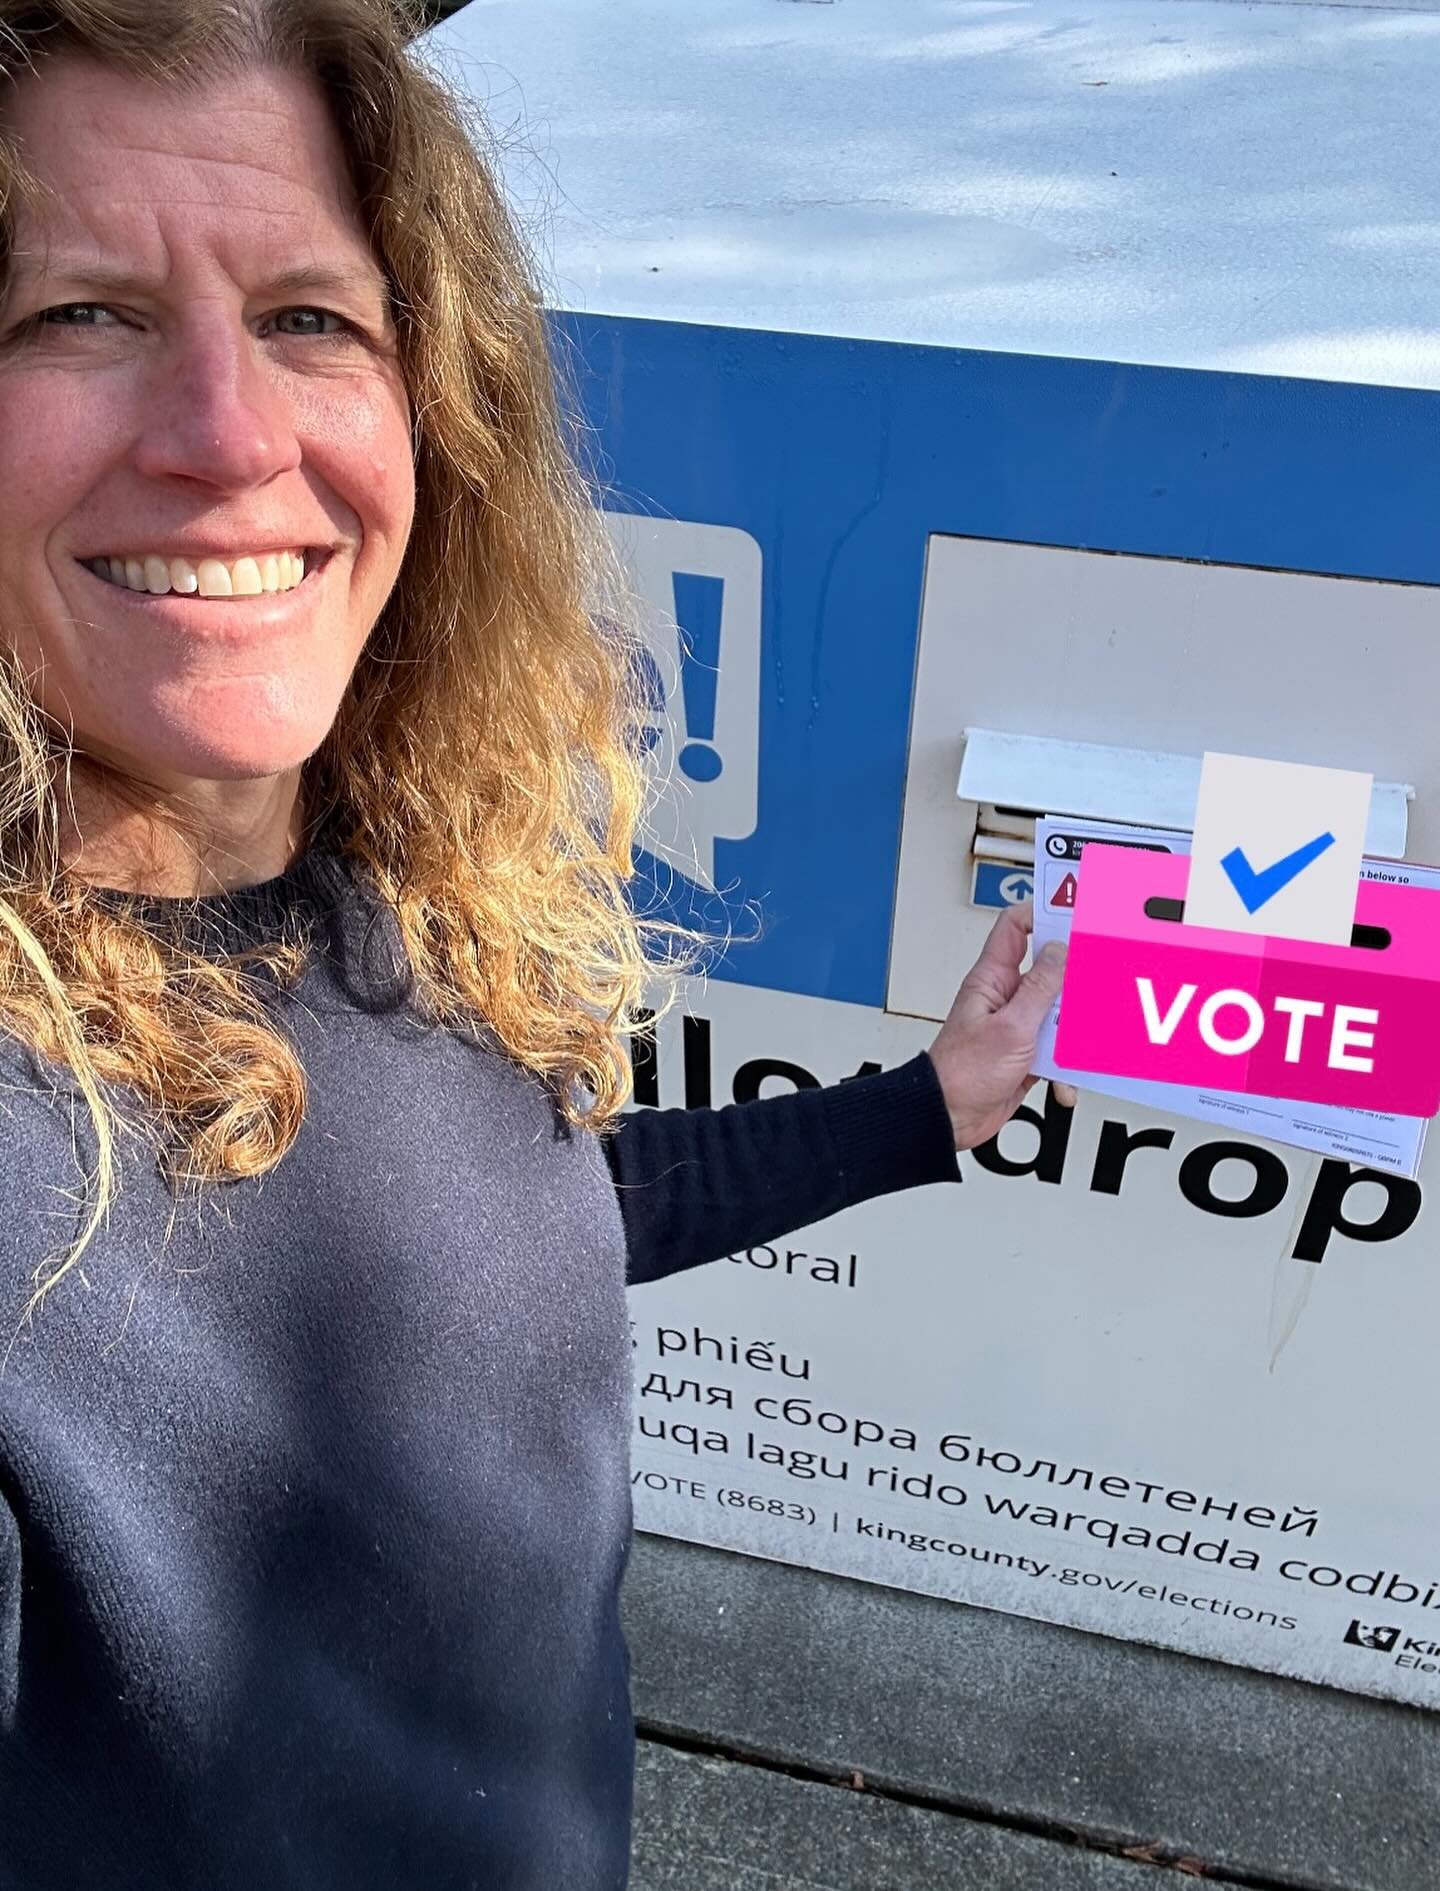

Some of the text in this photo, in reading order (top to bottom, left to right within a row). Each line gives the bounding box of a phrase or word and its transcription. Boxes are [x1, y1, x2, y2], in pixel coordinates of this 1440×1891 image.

[1367, 870, 1397, 882] below
[1397, 876, 1410, 884] so
[970, 1080, 1422, 1264] drop
[727, 1244, 857, 1288] oral
[657, 1326, 810, 1382] phiếu
[640, 1372, 1319, 1538] для сбора бюллетеней
[747, 1432, 849, 1481] lagu
[868, 1466, 968, 1508] rido
[984, 1494, 1261, 1573] warqadda
[717, 1488, 816, 1526] (8683)
[856, 1516, 1297, 1631] kingcounty.gov/elections
